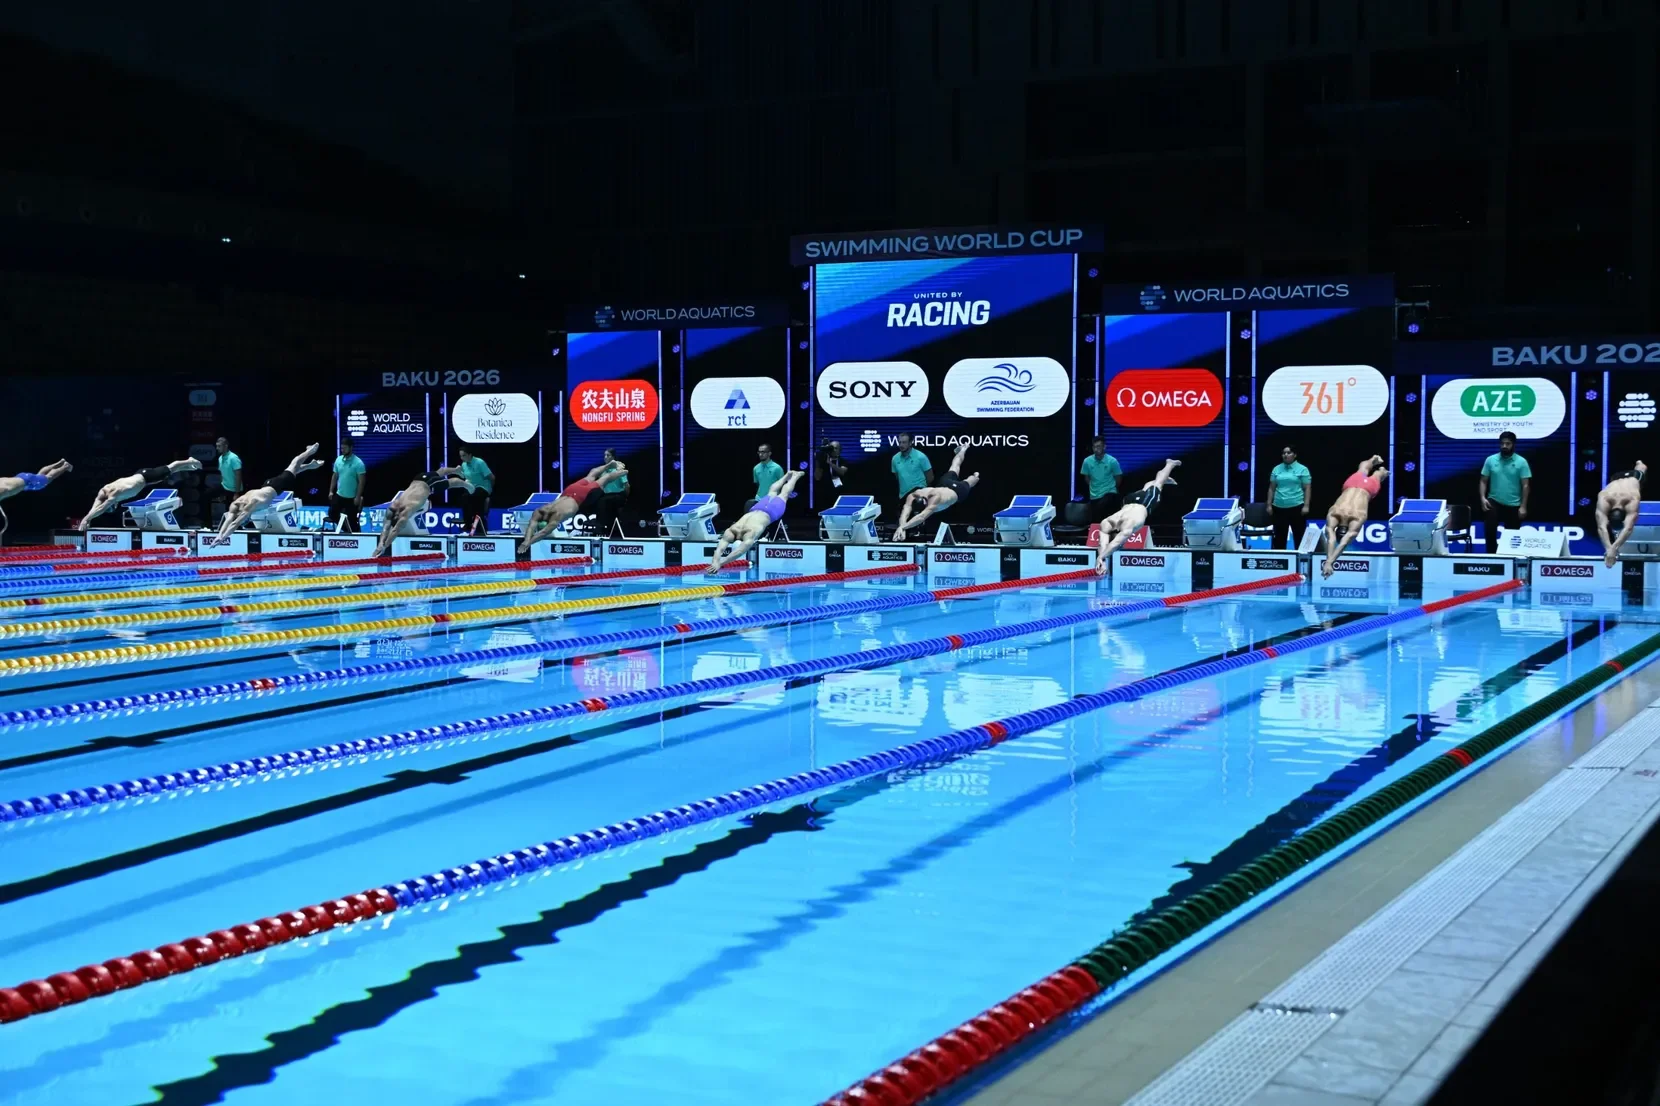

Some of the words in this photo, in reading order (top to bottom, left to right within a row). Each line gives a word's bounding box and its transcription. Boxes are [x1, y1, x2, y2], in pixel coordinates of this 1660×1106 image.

[805, 236, 929, 258] SWIMMING
[934, 232, 1025, 251] WORLD
[1030, 229, 1084, 247] CUP
[1174, 288, 1246, 302] WORLD
[1248, 284, 1350, 301] AQUATICS
[621, 308, 677, 321] WORLD
[677, 305, 756, 321] AQUATICS
[886, 300, 991, 328] RACING
[1492, 345, 1588, 367] BAKU
[382, 370, 440, 388] BAKU
[444, 369, 501, 386] 2026
[829, 380, 917, 399] SONY
[581, 388, 646, 410] 农夫山泉
[1142, 390, 1212, 408] OMEGA
[1472, 390, 1522, 412] AZE
[372, 413, 411, 423] WORLD
[477, 417, 513, 428] Botanica
[582, 412, 614, 423] NONGFU
[616, 411, 646, 422] SPRING
[728, 414, 747, 427] rct
[372, 423, 424, 434] AQUATICS
[475, 429, 515, 440] Residence
[888, 435, 945, 447] WRLD
[948, 434, 1029, 447] AQUATICS
[167, 514, 173, 523] 9
[287, 515, 293, 525] 8
[707, 522, 712, 533] 5
[774, 549, 803, 557] OMEGA
[944, 553, 975, 561] OMEGA
[1131, 556, 1164, 565] OMEGA
[1333, 562, 1369, 570] OMEGA
[1553, 567, 1593, 576] OMEGA
